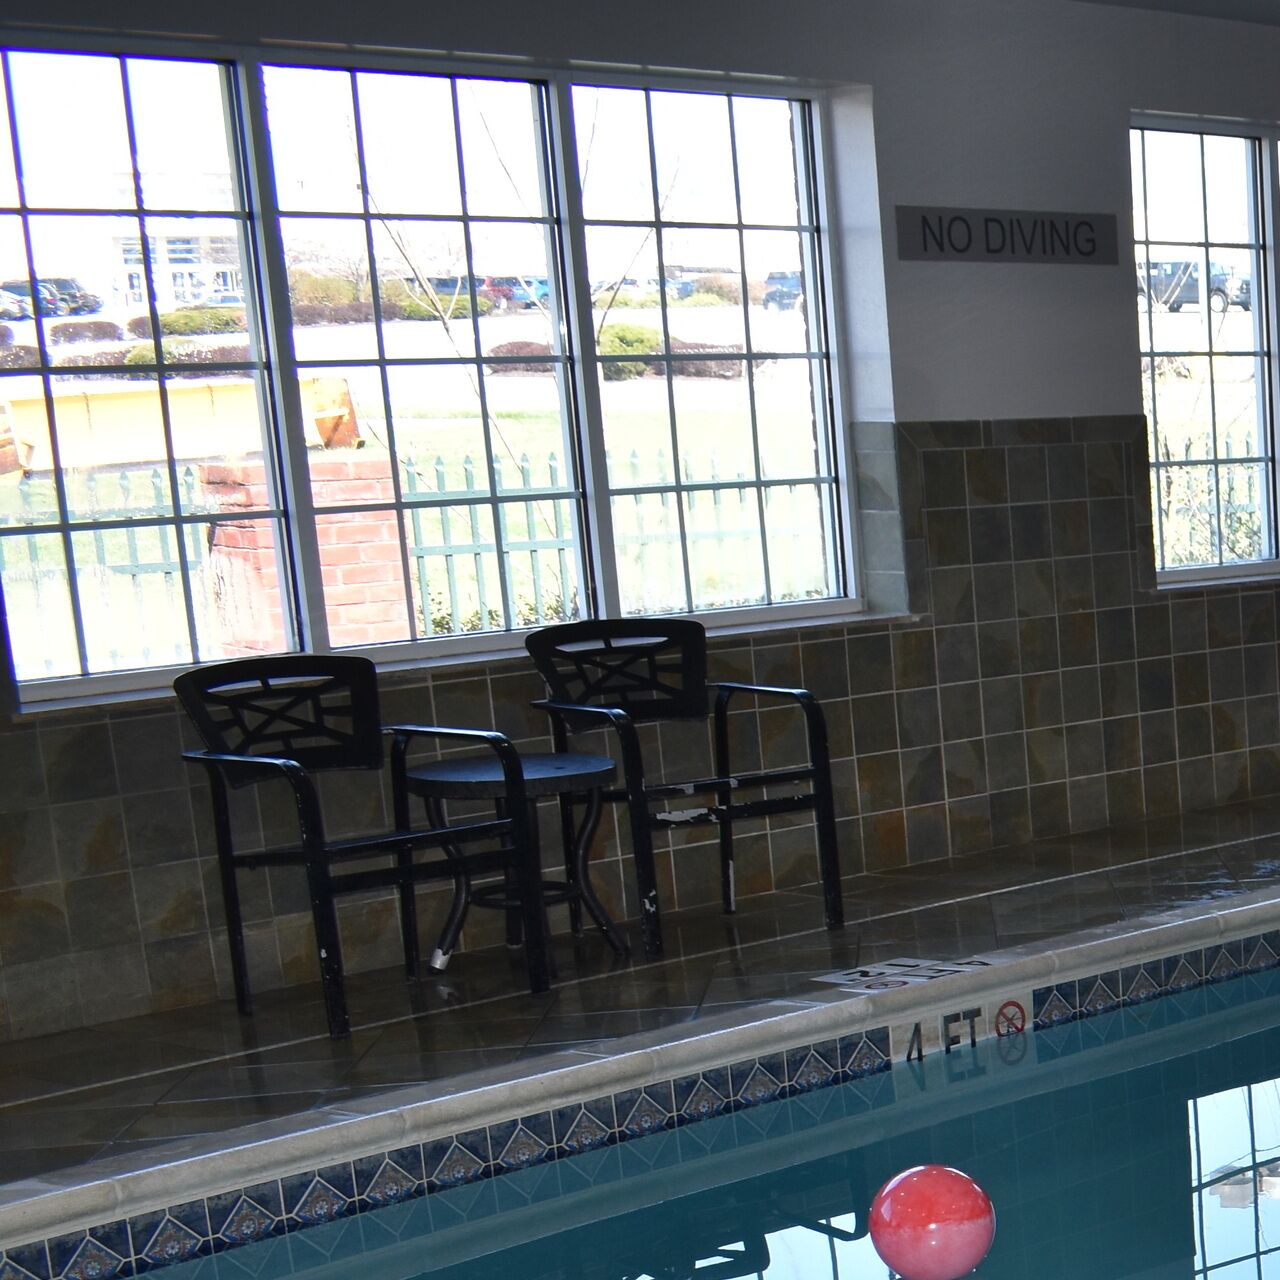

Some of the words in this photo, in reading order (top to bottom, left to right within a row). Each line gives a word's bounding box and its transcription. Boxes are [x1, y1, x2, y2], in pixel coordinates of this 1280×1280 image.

[921, 215, 972, 253] NO
[984, 217, 1096, 257] DIVING
[943, 1007, 982, 1055] FT
